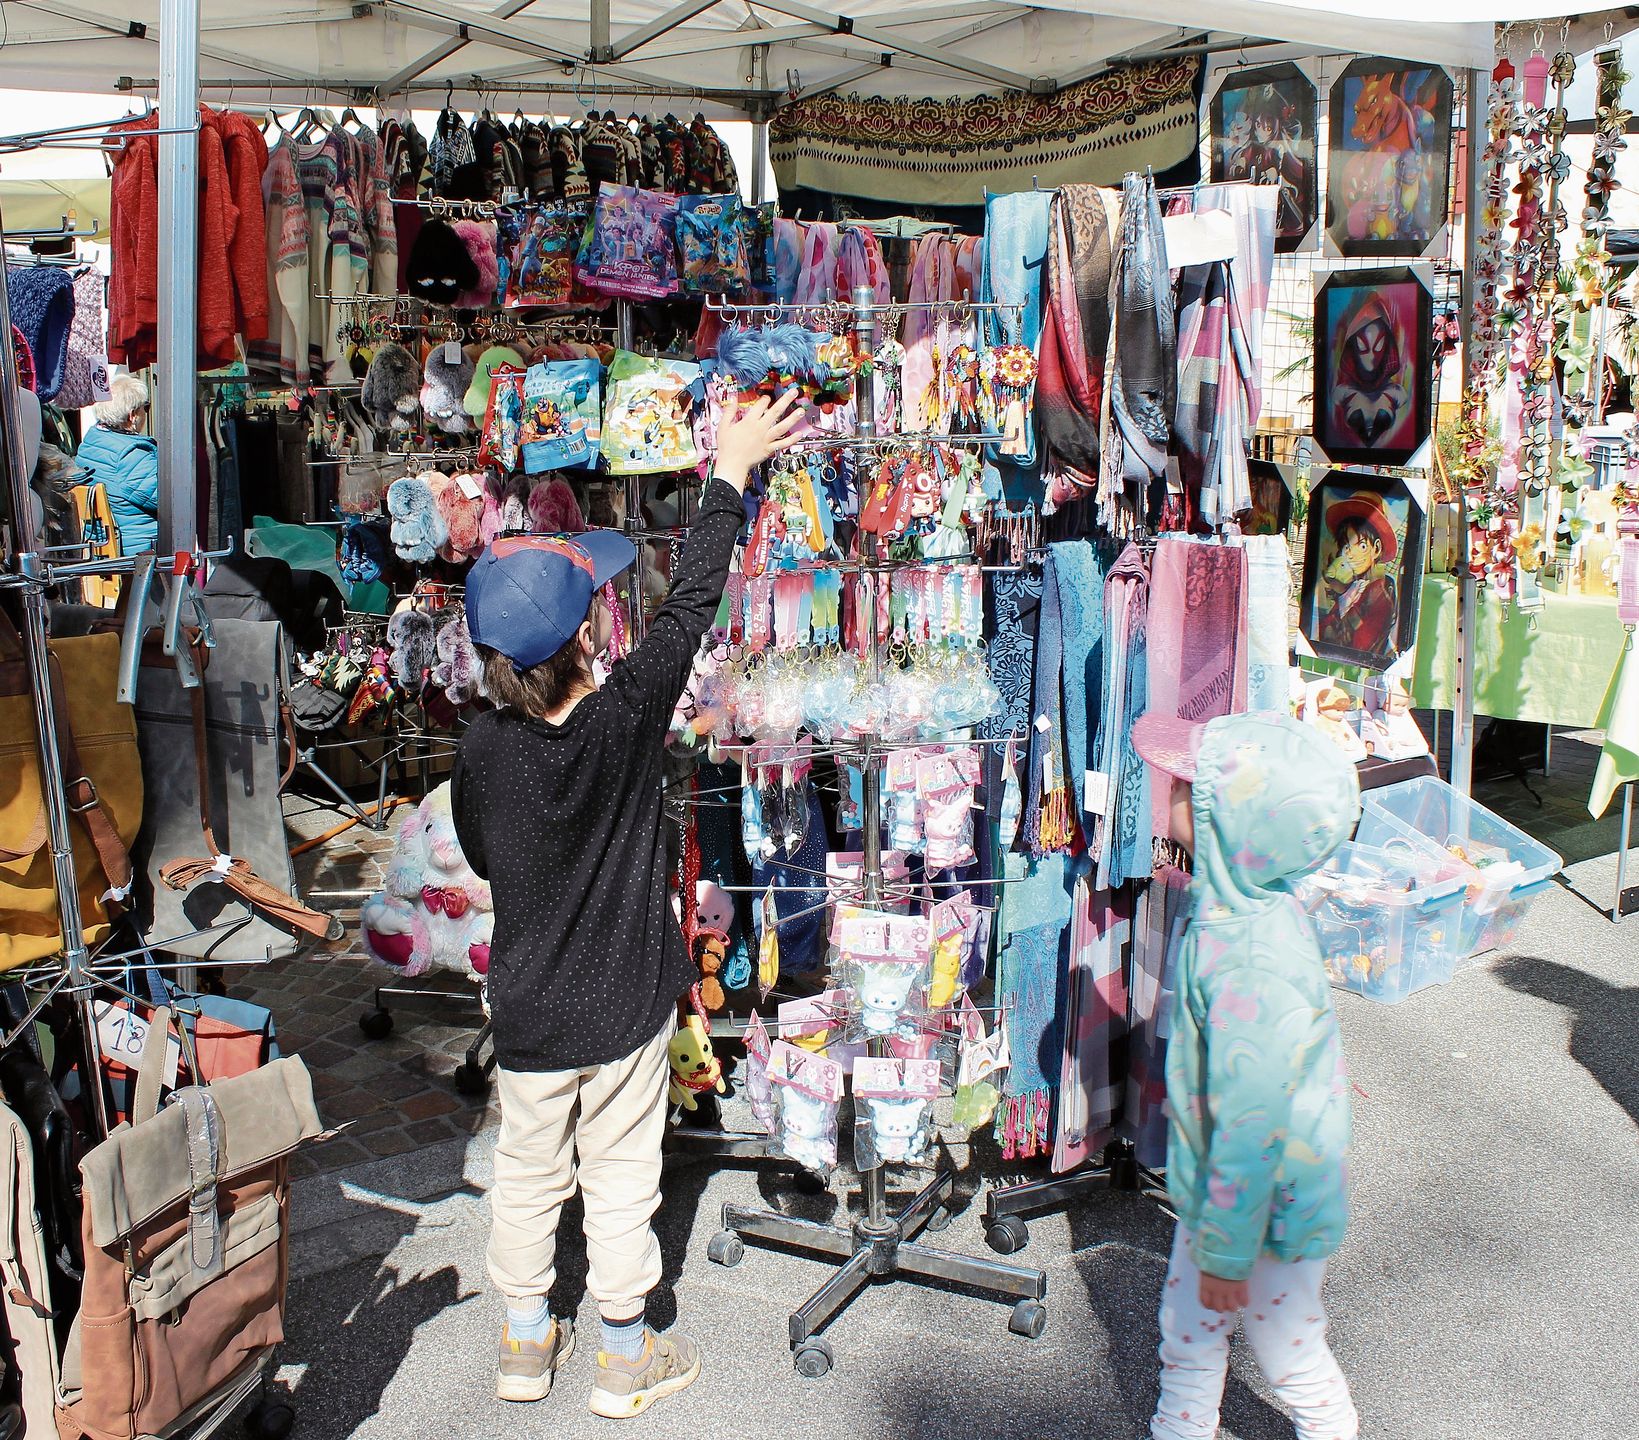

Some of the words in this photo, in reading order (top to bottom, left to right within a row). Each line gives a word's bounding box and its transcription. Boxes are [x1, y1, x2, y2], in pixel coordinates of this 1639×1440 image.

[600, 267, 629, 277] DEMON
[630, 273, 658, 282] HUNTERS
[728, 582, 739, 616] Bubble
[110, 1017, 145, 1053] 18
